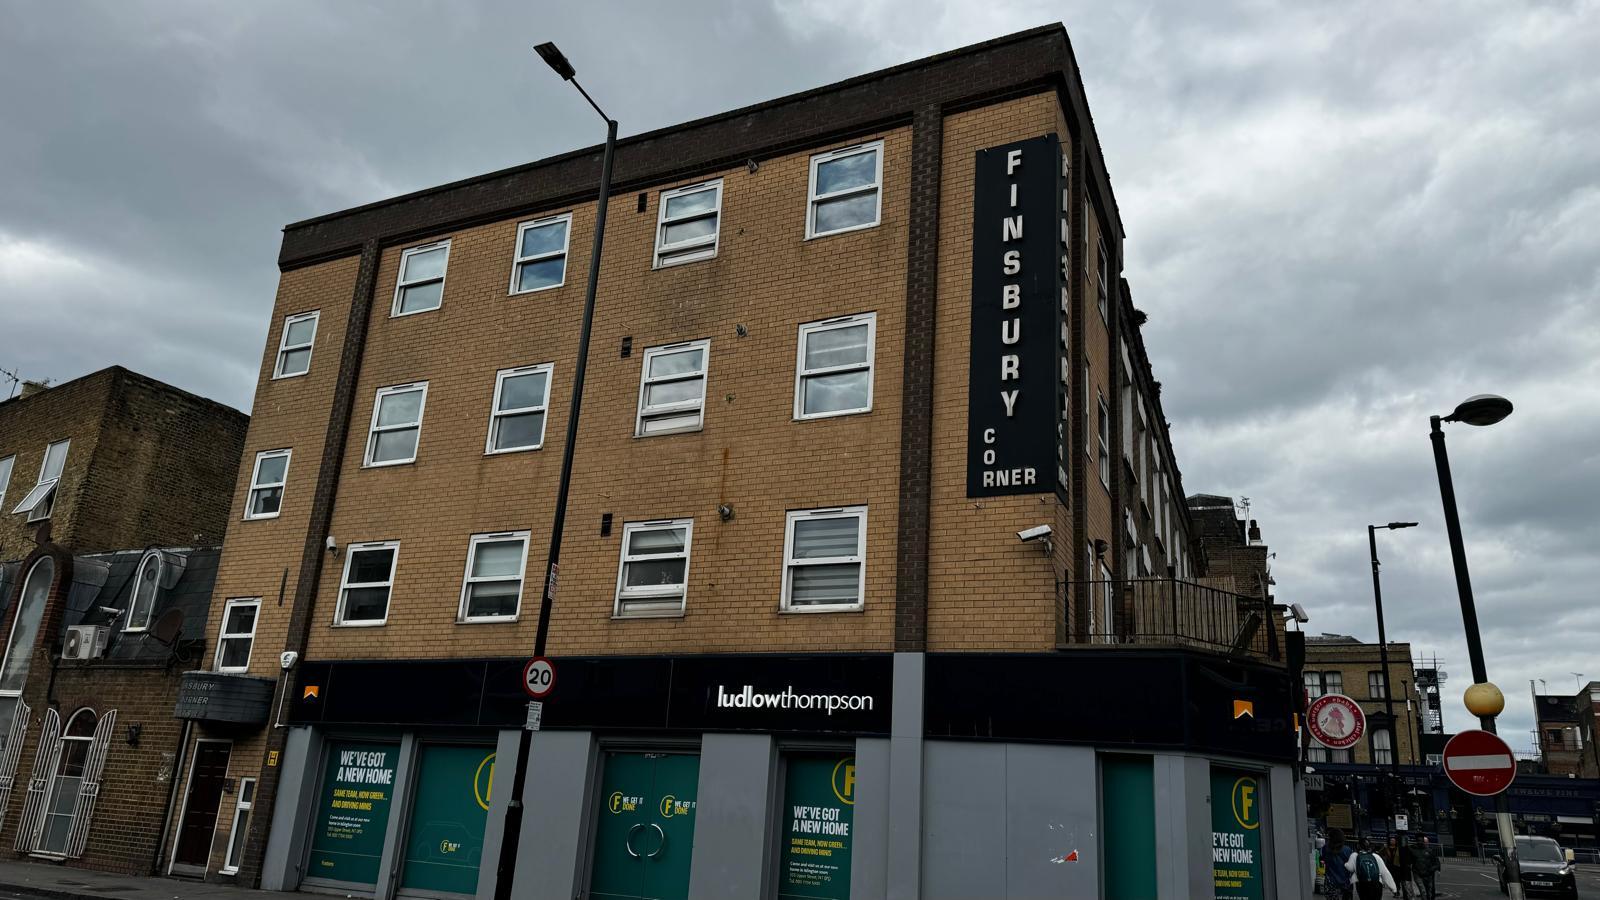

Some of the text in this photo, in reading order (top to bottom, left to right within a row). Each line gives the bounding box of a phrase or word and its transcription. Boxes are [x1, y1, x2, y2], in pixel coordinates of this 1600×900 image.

[1001, 149, 1023, 417] FINSBURY
[529, 668, 551, 685] 20
[717, 685, 873, 715] ludlowthompson
[340, 750, 387, 768] WE'VE GOT
[336, 766, 393, 784] A NEW HOME
[1241, 785, 1254, 821] F
[793, 805, 840, 821] WE'VE GOT
[792, 819, 849, 836] A NEW HOME
[1212, 832, 1244, 848] E'VE GOT
[1212, 848, 1253, 864] NEW HOME
